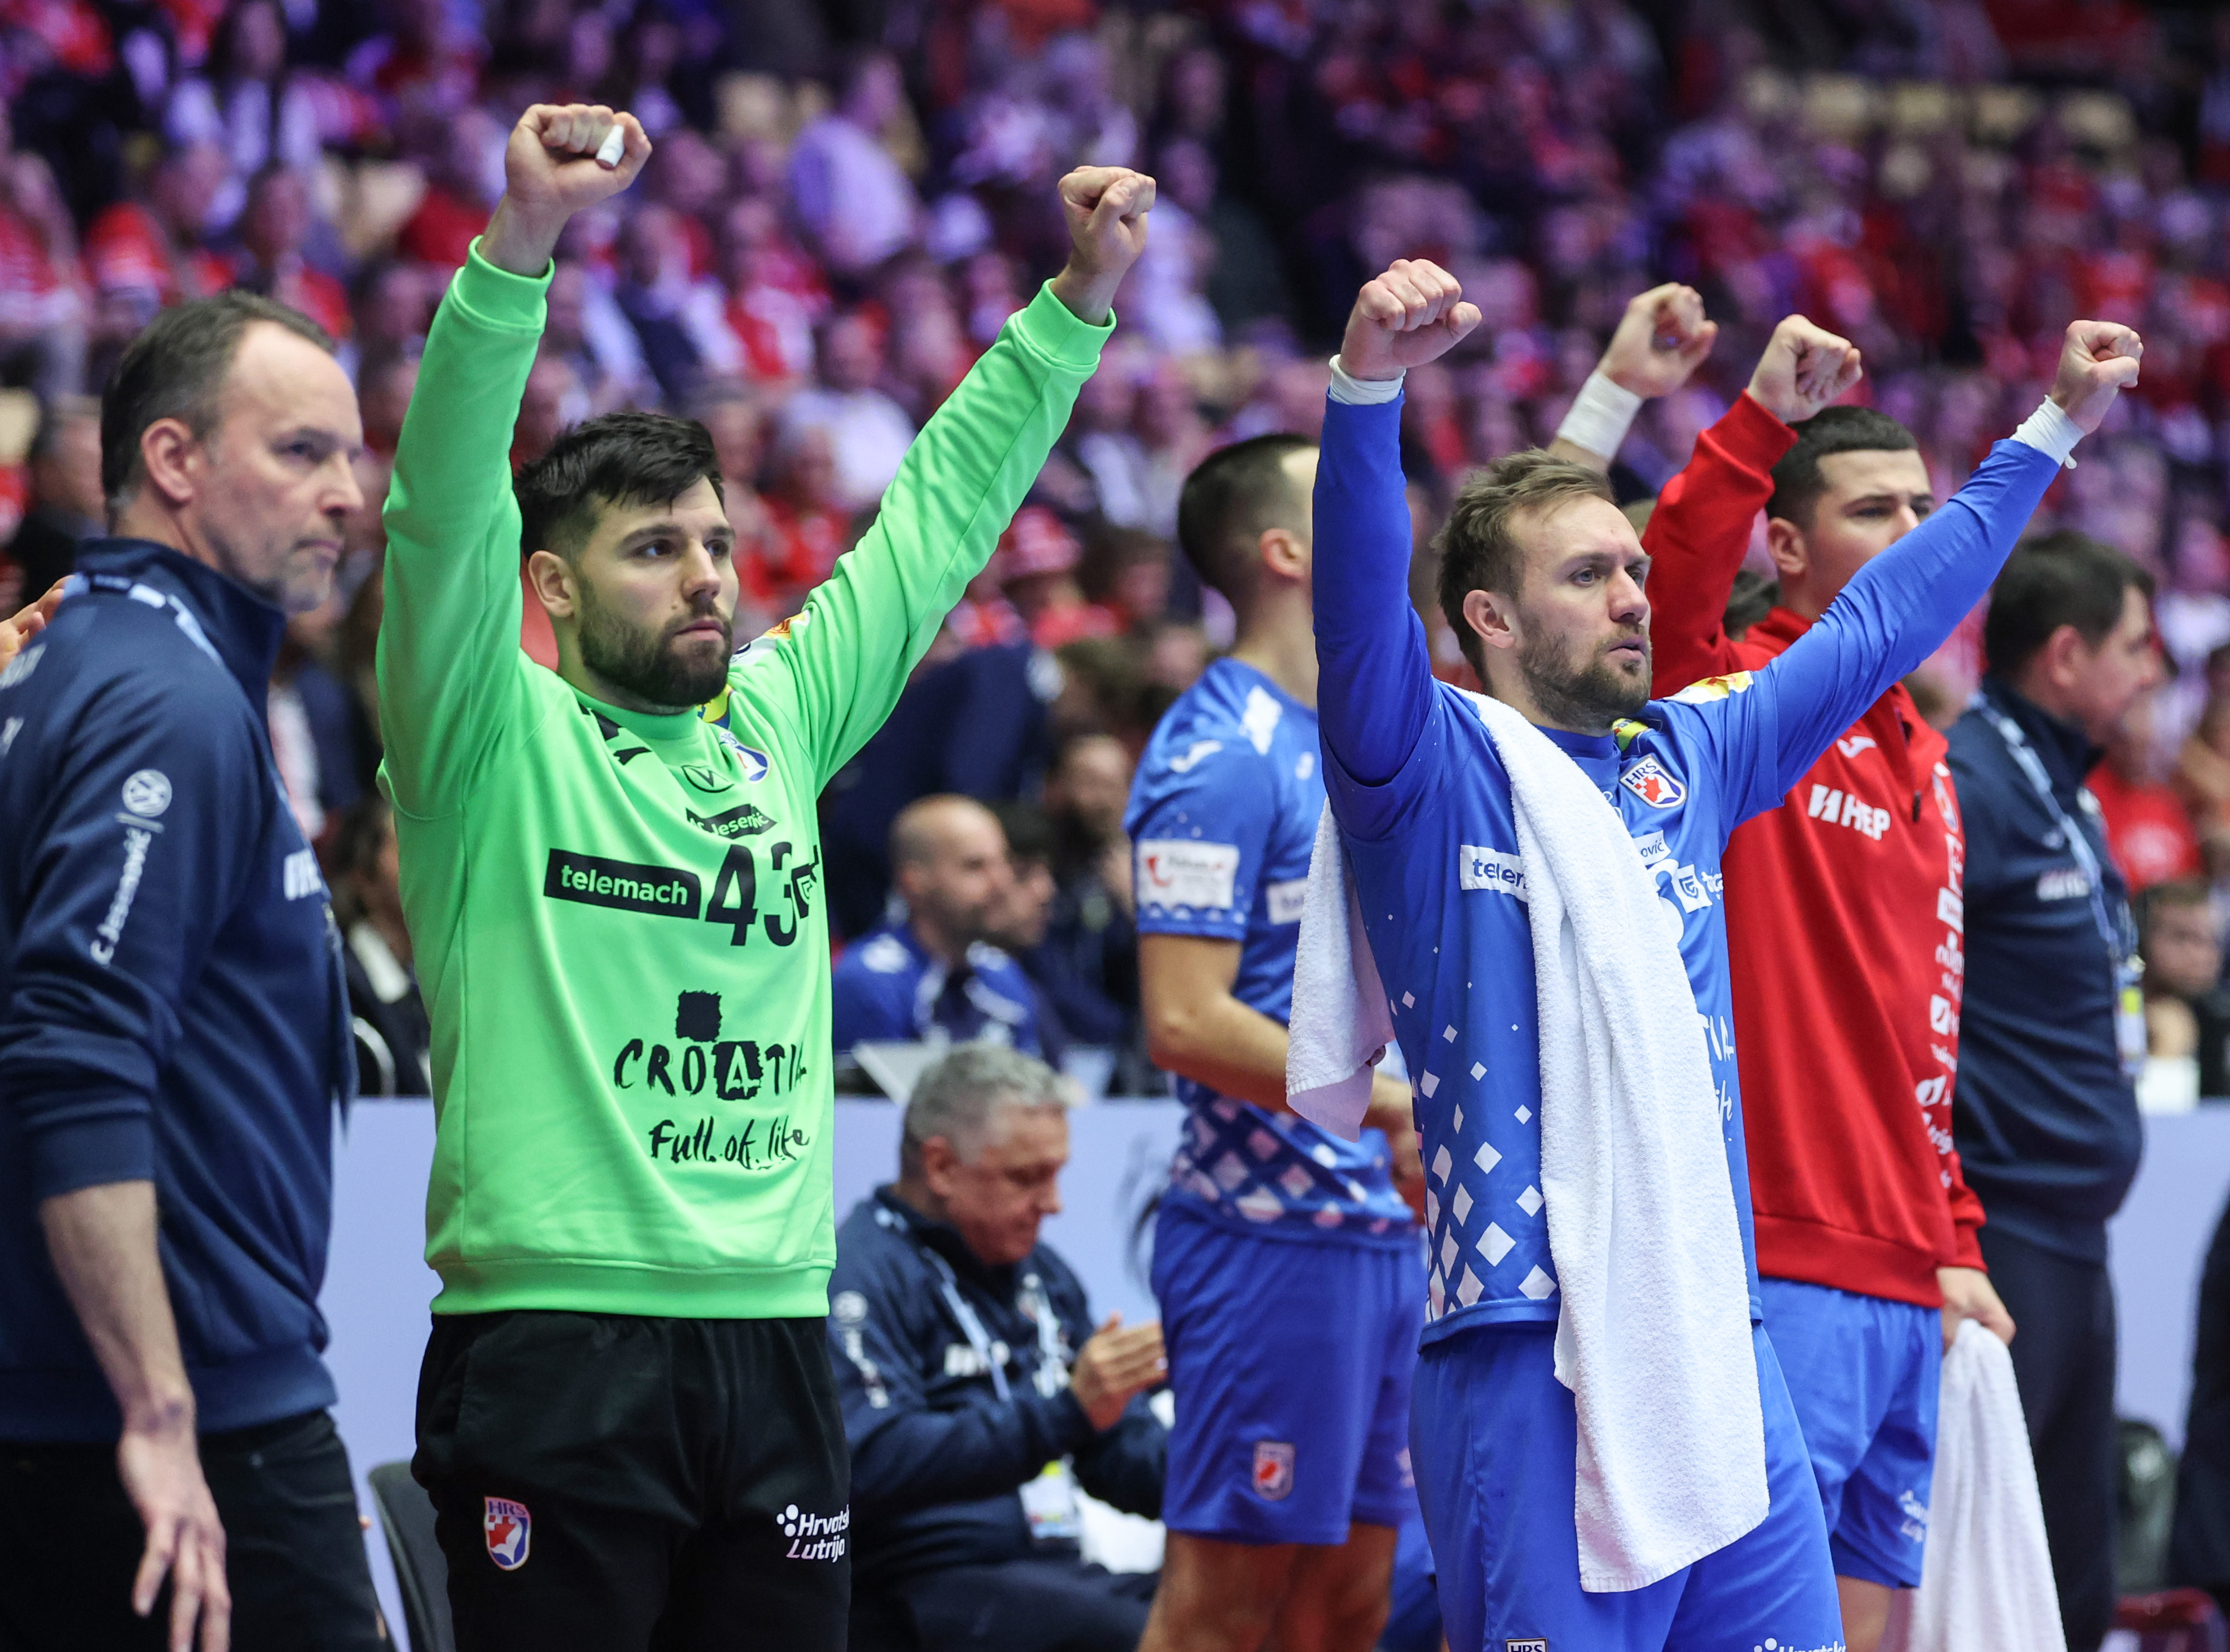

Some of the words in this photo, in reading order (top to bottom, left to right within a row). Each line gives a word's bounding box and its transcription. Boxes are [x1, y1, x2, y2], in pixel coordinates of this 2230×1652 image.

[1625, 761, 1657, 785] HRS
[1641, 838, 1665, 858] ović
[561, 864, 689, 905] telemach
[705, 841, 797, 947] 43
[725, 1119, 756, 1170] of
[488, 1500, 526, 1516] HRS
[786, 1534, 845, 1563] Lutrija
